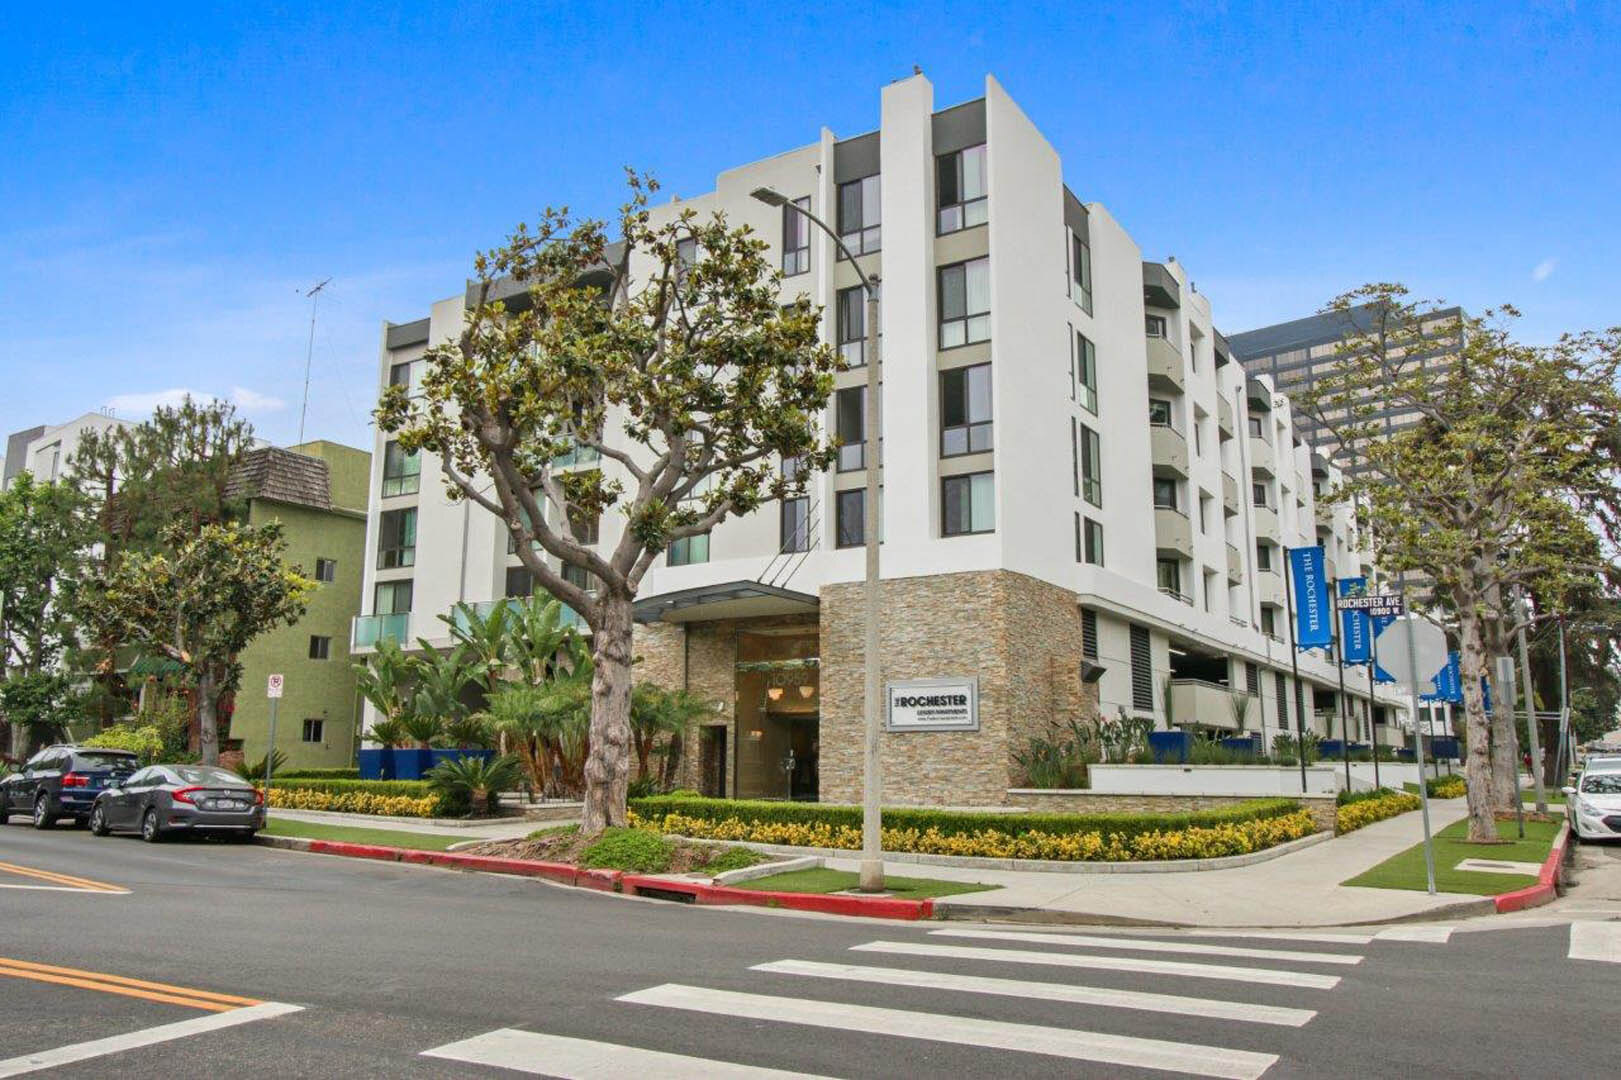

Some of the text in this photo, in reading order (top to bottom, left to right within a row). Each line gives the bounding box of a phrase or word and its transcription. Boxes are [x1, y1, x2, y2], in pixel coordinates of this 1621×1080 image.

[1303, 552, 1319, 632] THE ROCHESTER
[1336, 597, 1384, 609] ROCHESTER
[900, 694, 967, 707] ROCHESTER
